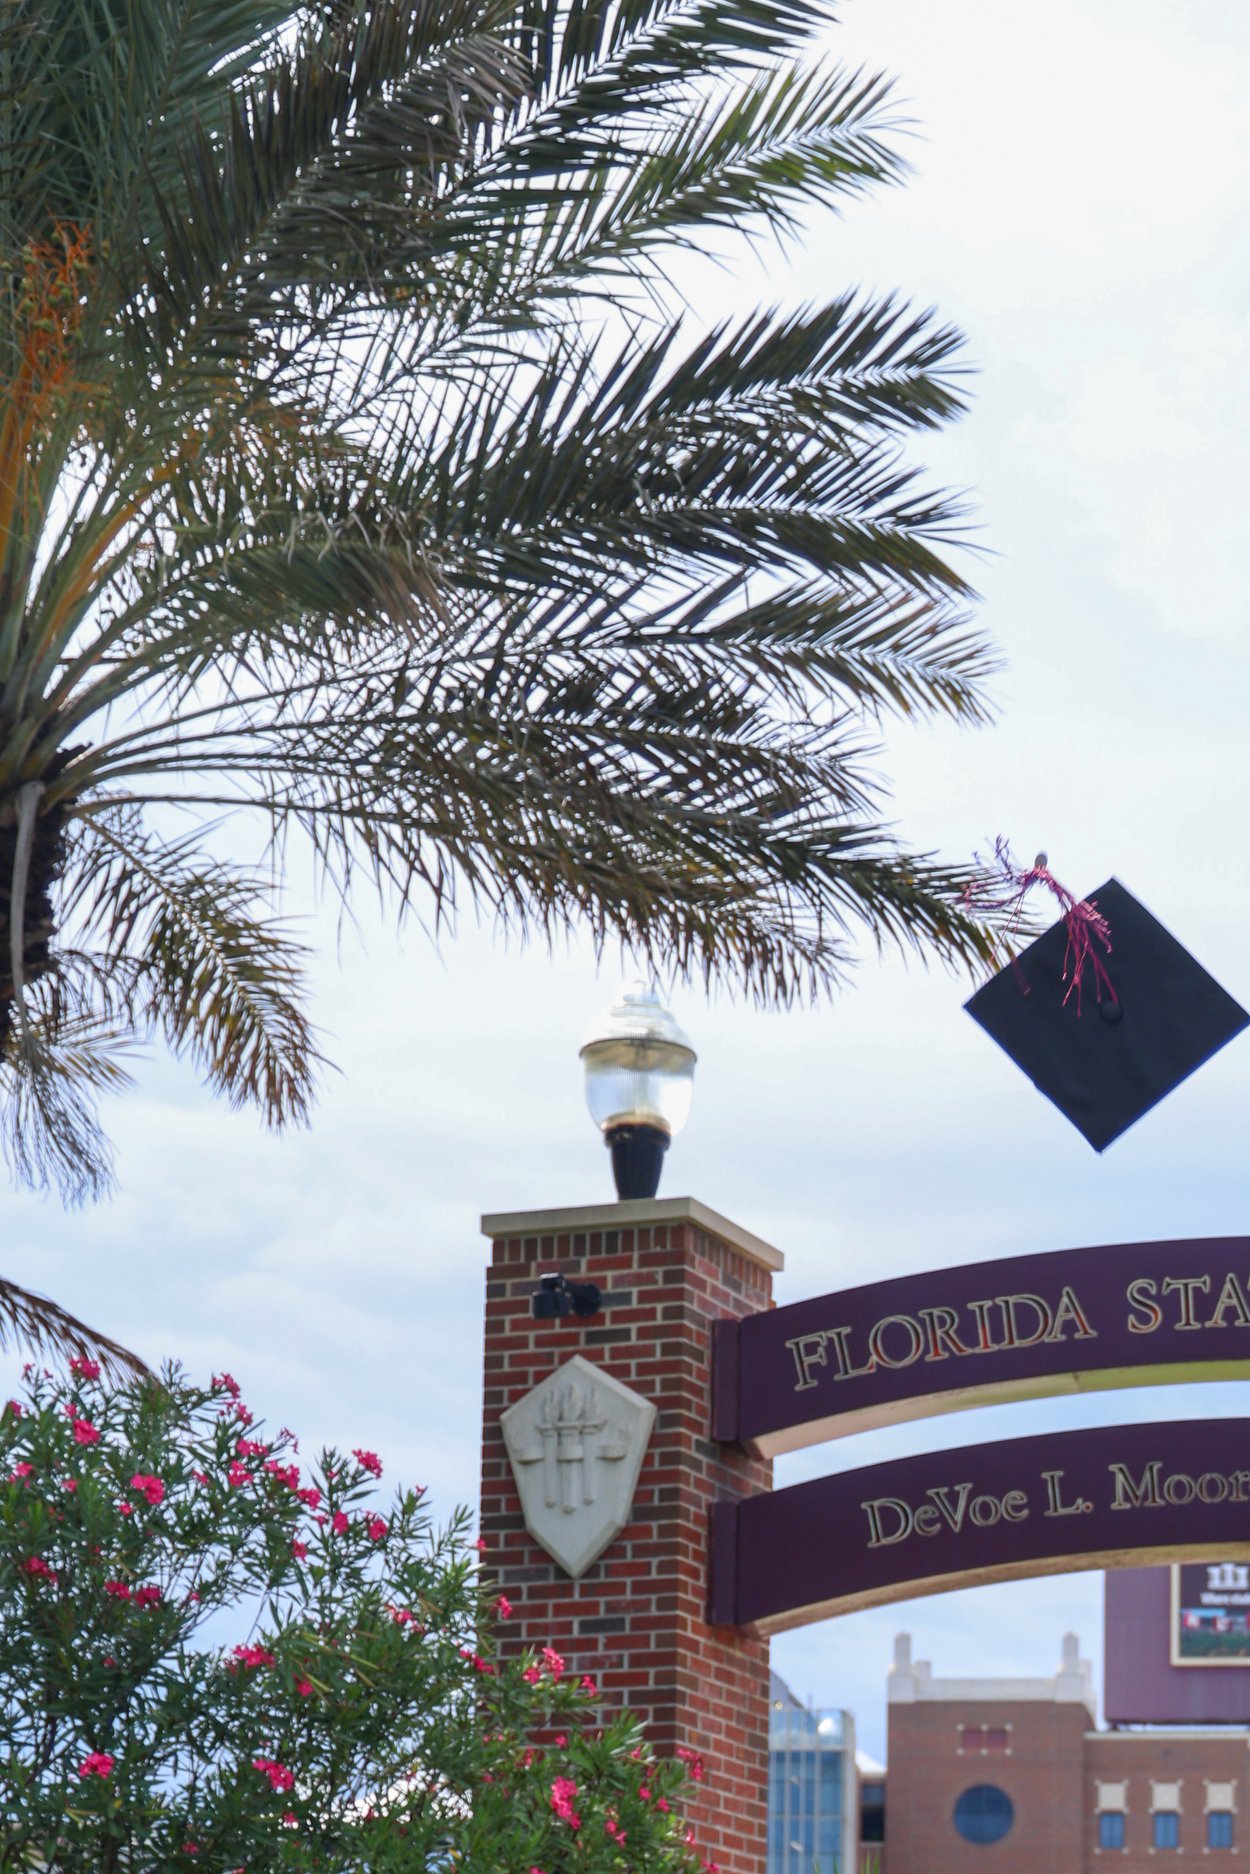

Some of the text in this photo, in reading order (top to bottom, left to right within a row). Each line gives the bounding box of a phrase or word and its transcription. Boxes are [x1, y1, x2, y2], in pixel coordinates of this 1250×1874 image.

[785, 1287, 1097, 1392] FLORIDA
[861, 1482, 1029, 1549] DeVoe
[1041, 1470, 1095, 1517] L.
